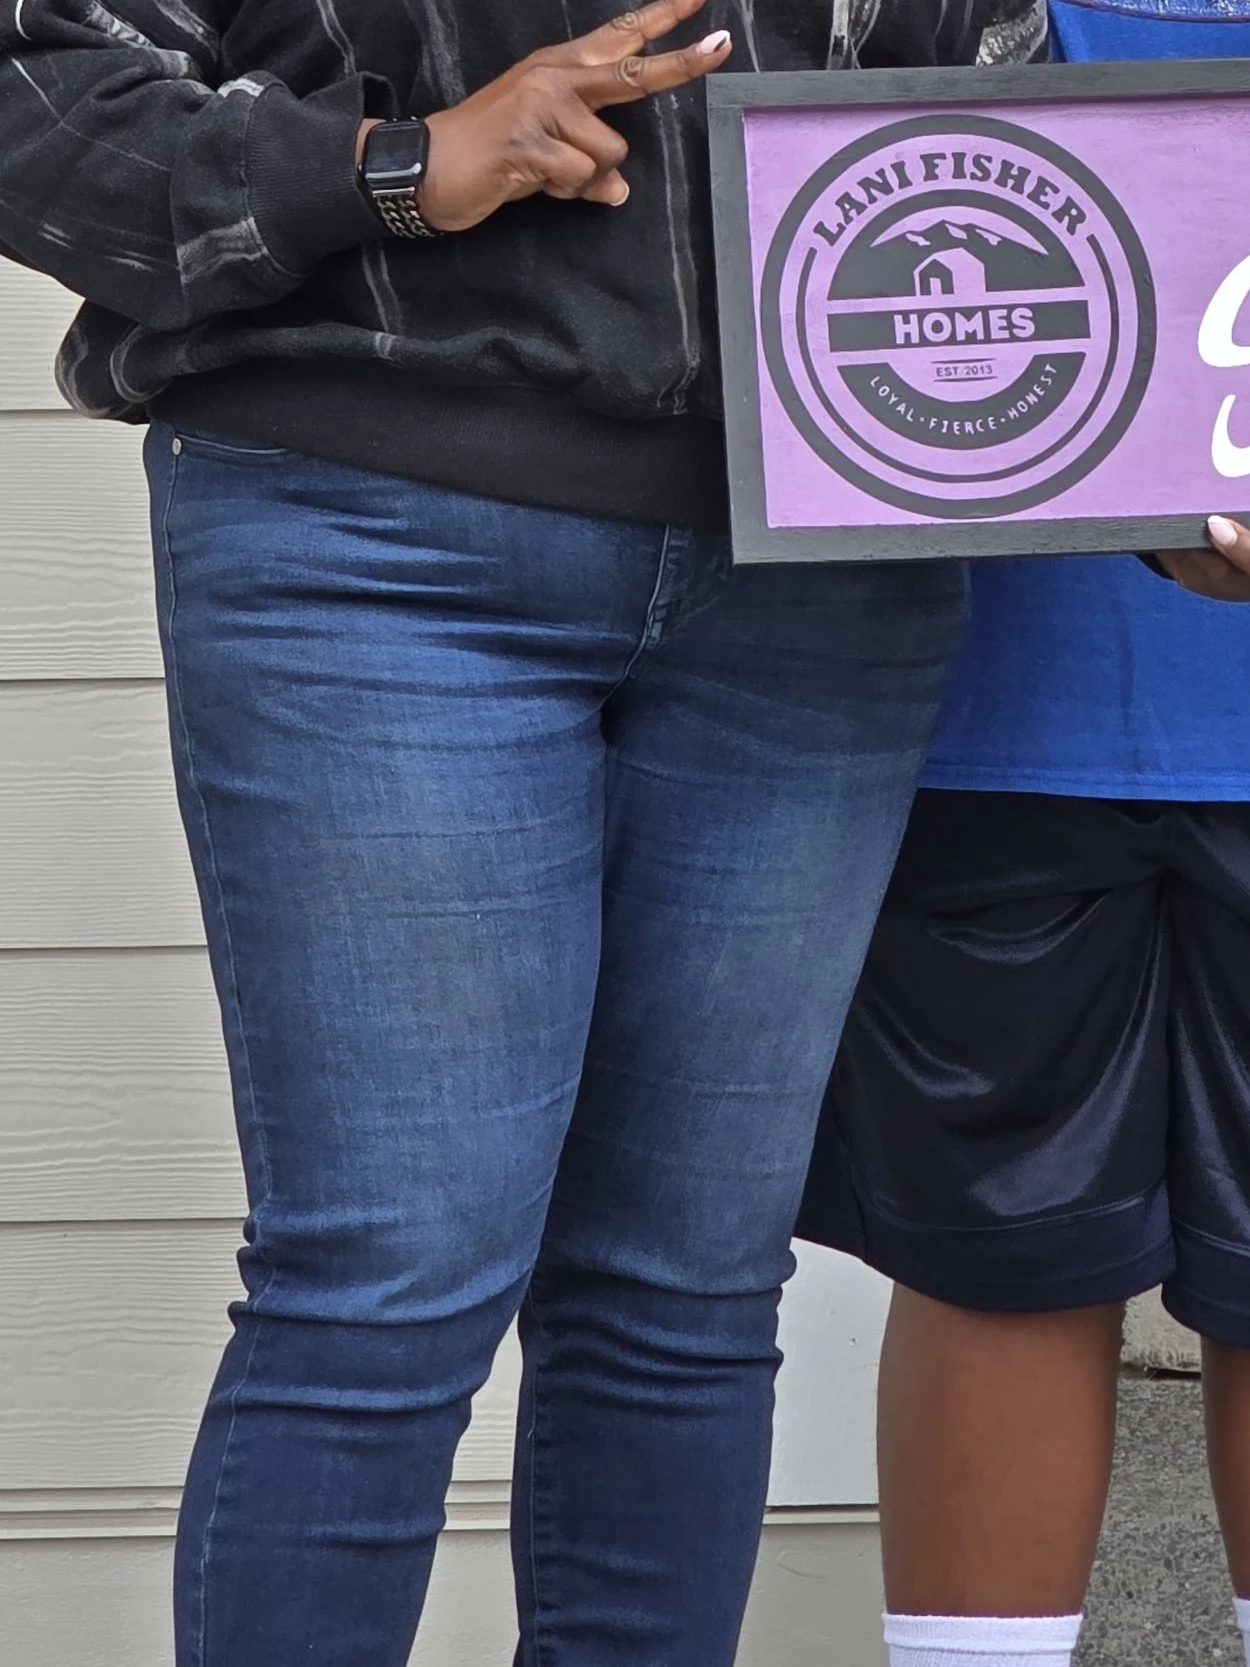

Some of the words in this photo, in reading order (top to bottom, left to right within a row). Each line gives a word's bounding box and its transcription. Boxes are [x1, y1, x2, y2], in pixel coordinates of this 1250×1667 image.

[813, 160, 912, 247] LANI
[919, 151, 1088, 236] FISHER
[893, 307, 1036, 345] HOMES
[935, 366, 960, 377] EST
[965, 365, 994, 376] 2013
[870, 376, 914, 422] LOYAL
[928, 416, 998, 435] FIERCE
[1007, 363, 1057, 420] HONEST
